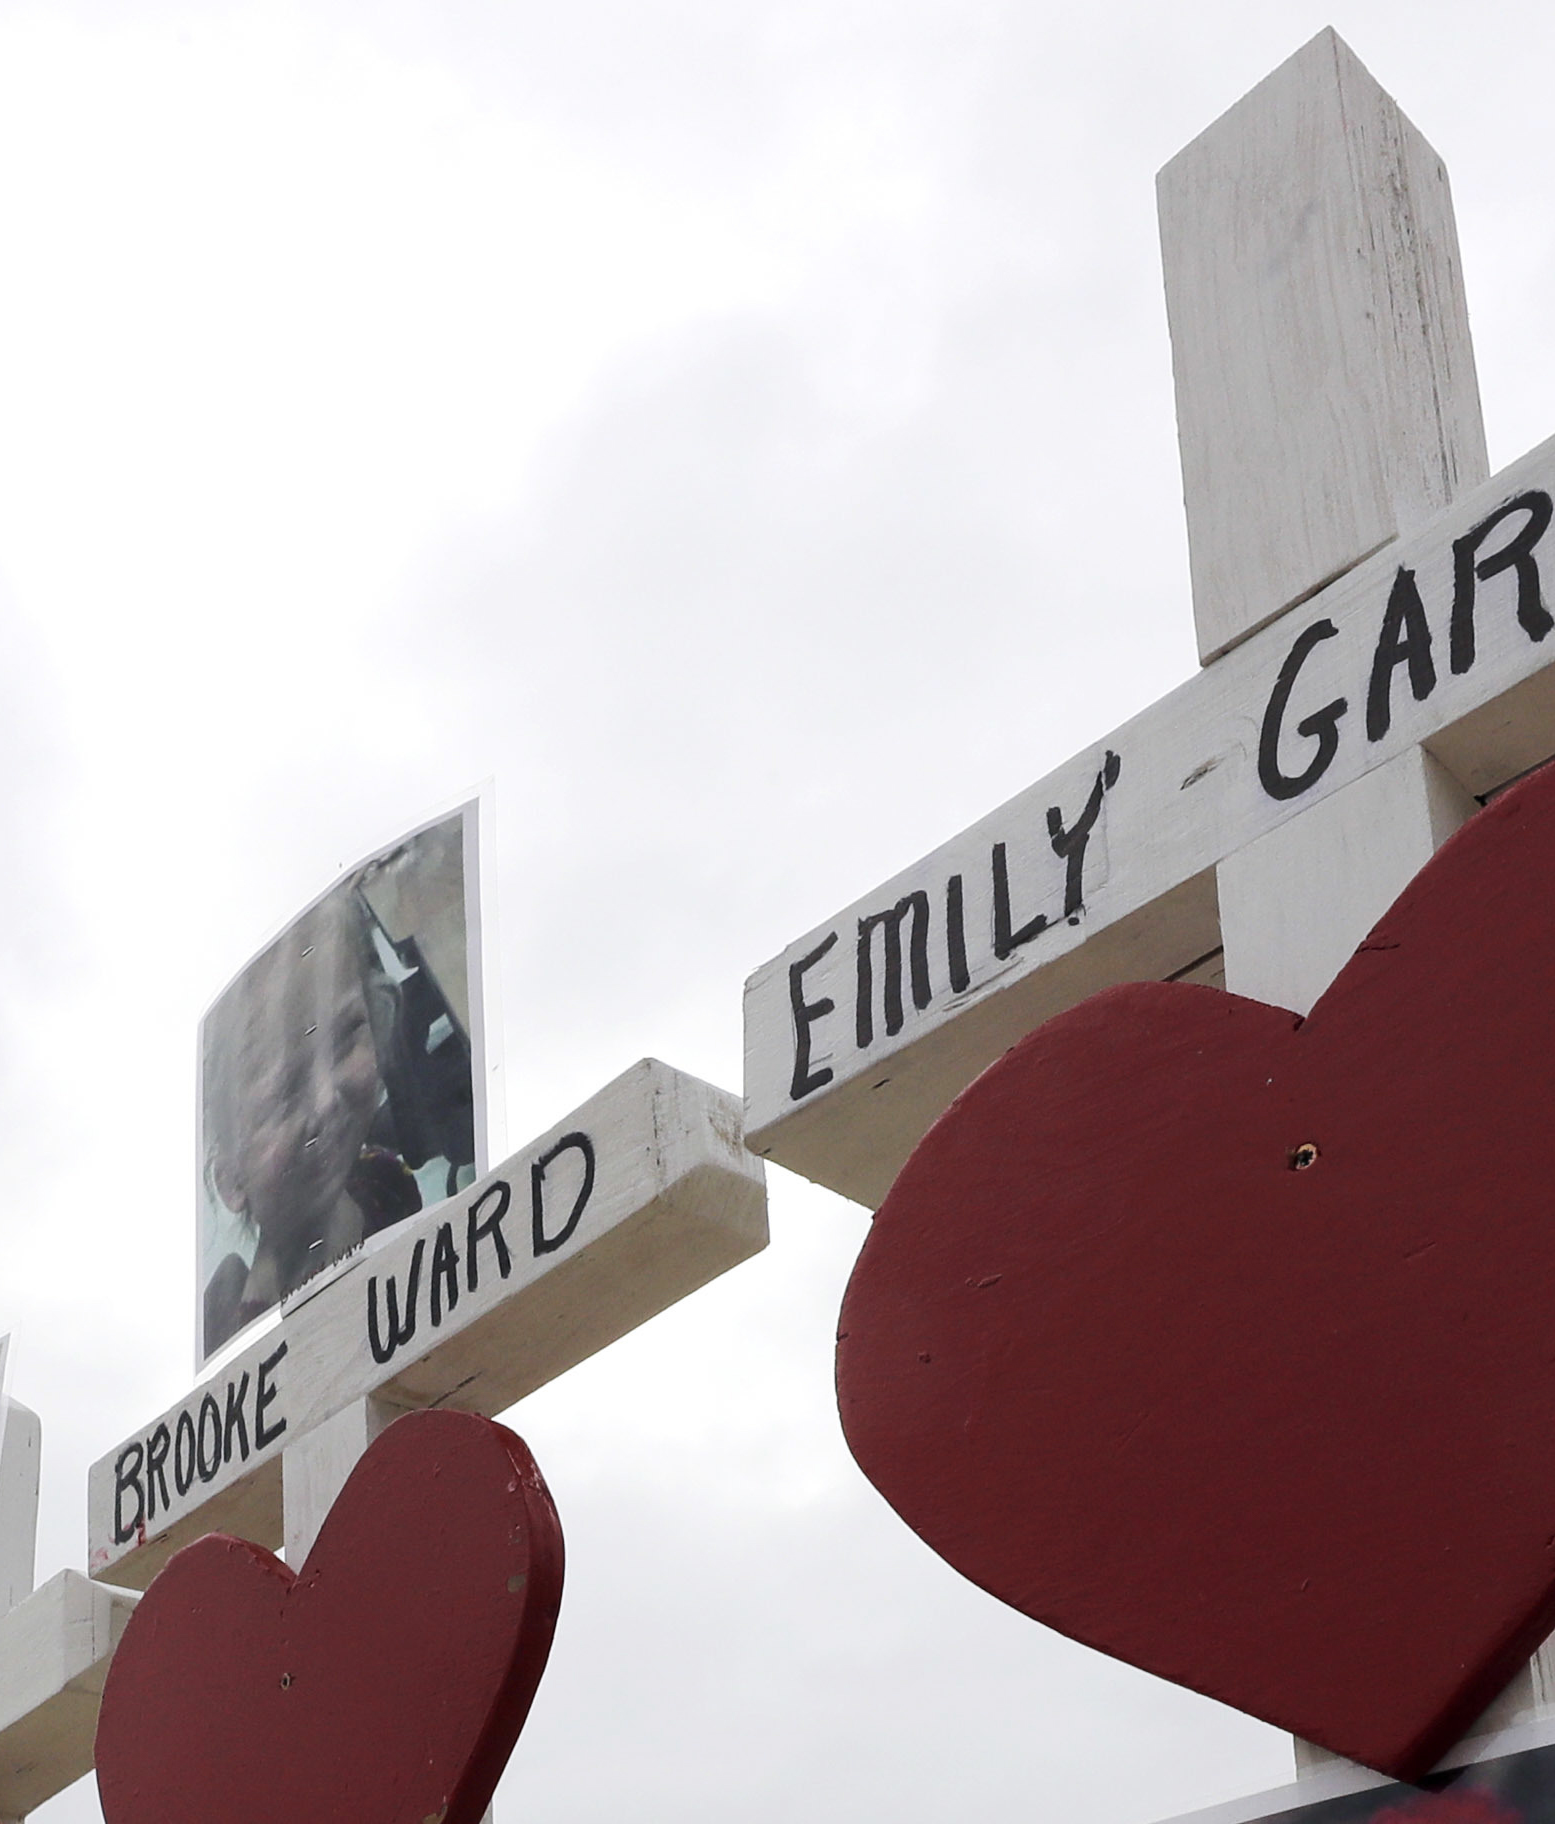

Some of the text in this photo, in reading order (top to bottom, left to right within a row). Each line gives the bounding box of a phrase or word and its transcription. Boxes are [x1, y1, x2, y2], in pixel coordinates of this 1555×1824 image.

[789, 751, 1122, 1101] EMILY
[114, 1131, 596, 1545] BROOKE WARD
